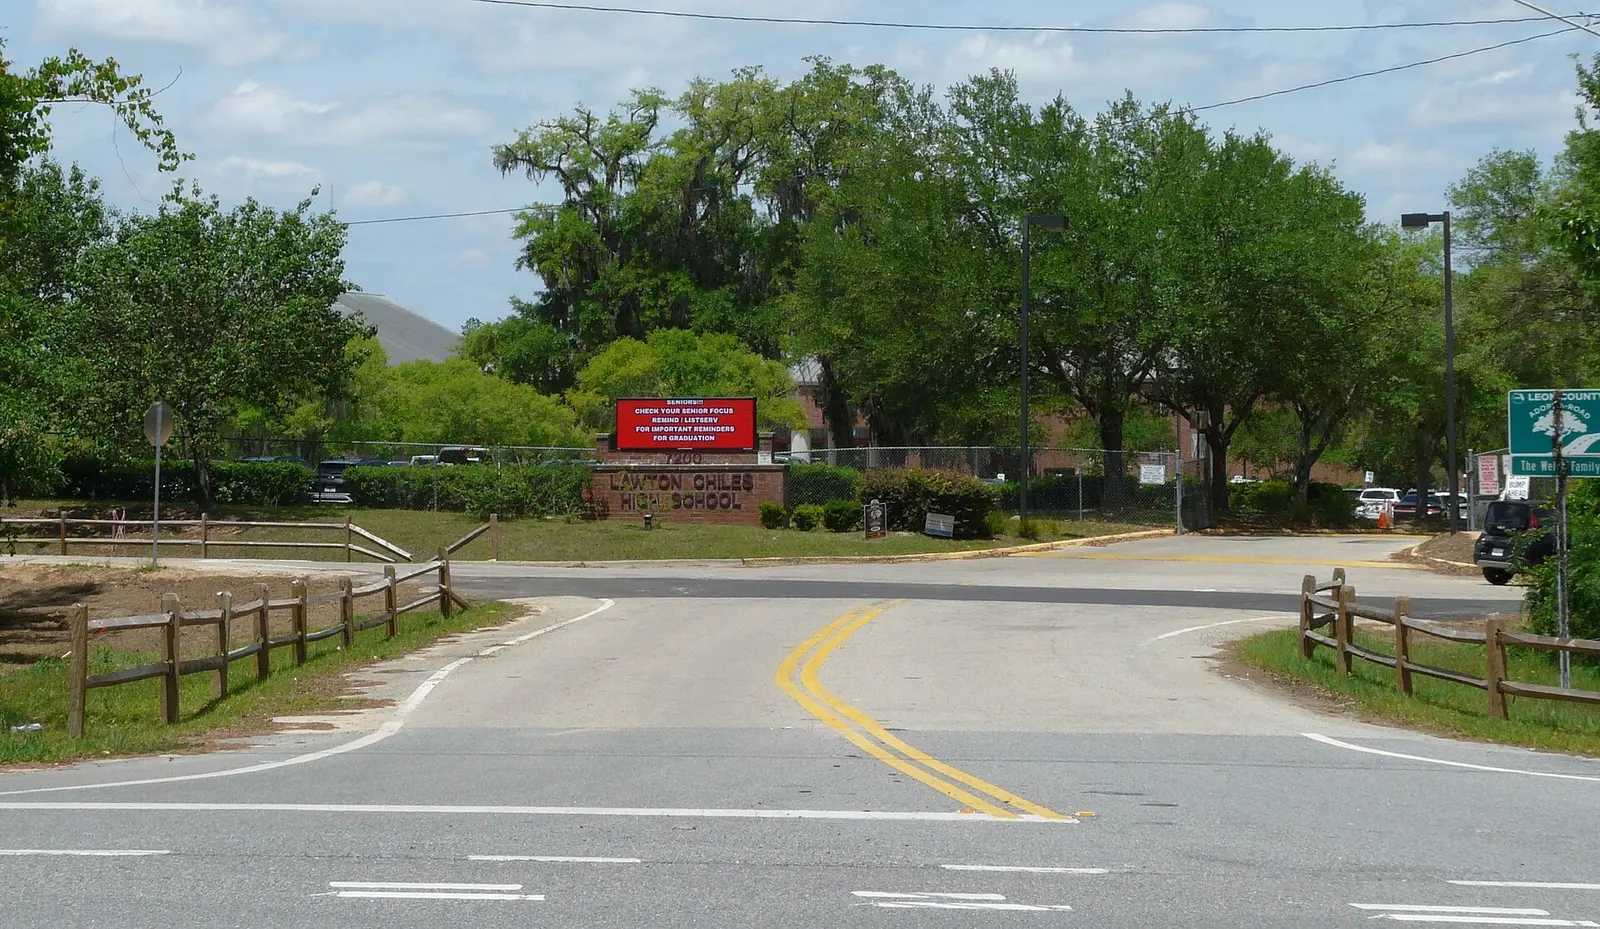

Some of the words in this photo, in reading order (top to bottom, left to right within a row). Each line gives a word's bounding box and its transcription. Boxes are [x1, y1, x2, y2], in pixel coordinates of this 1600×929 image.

[665, 453, 702, 464] 7200
[1521, 460, 1536, 471] The
[1571, 460, 1600, 475] Family
[610, 474, 682, 491] LAWTON
[693, 473, 754, 491] CHILES
[671, 492, 742, 510] SCHOOL
